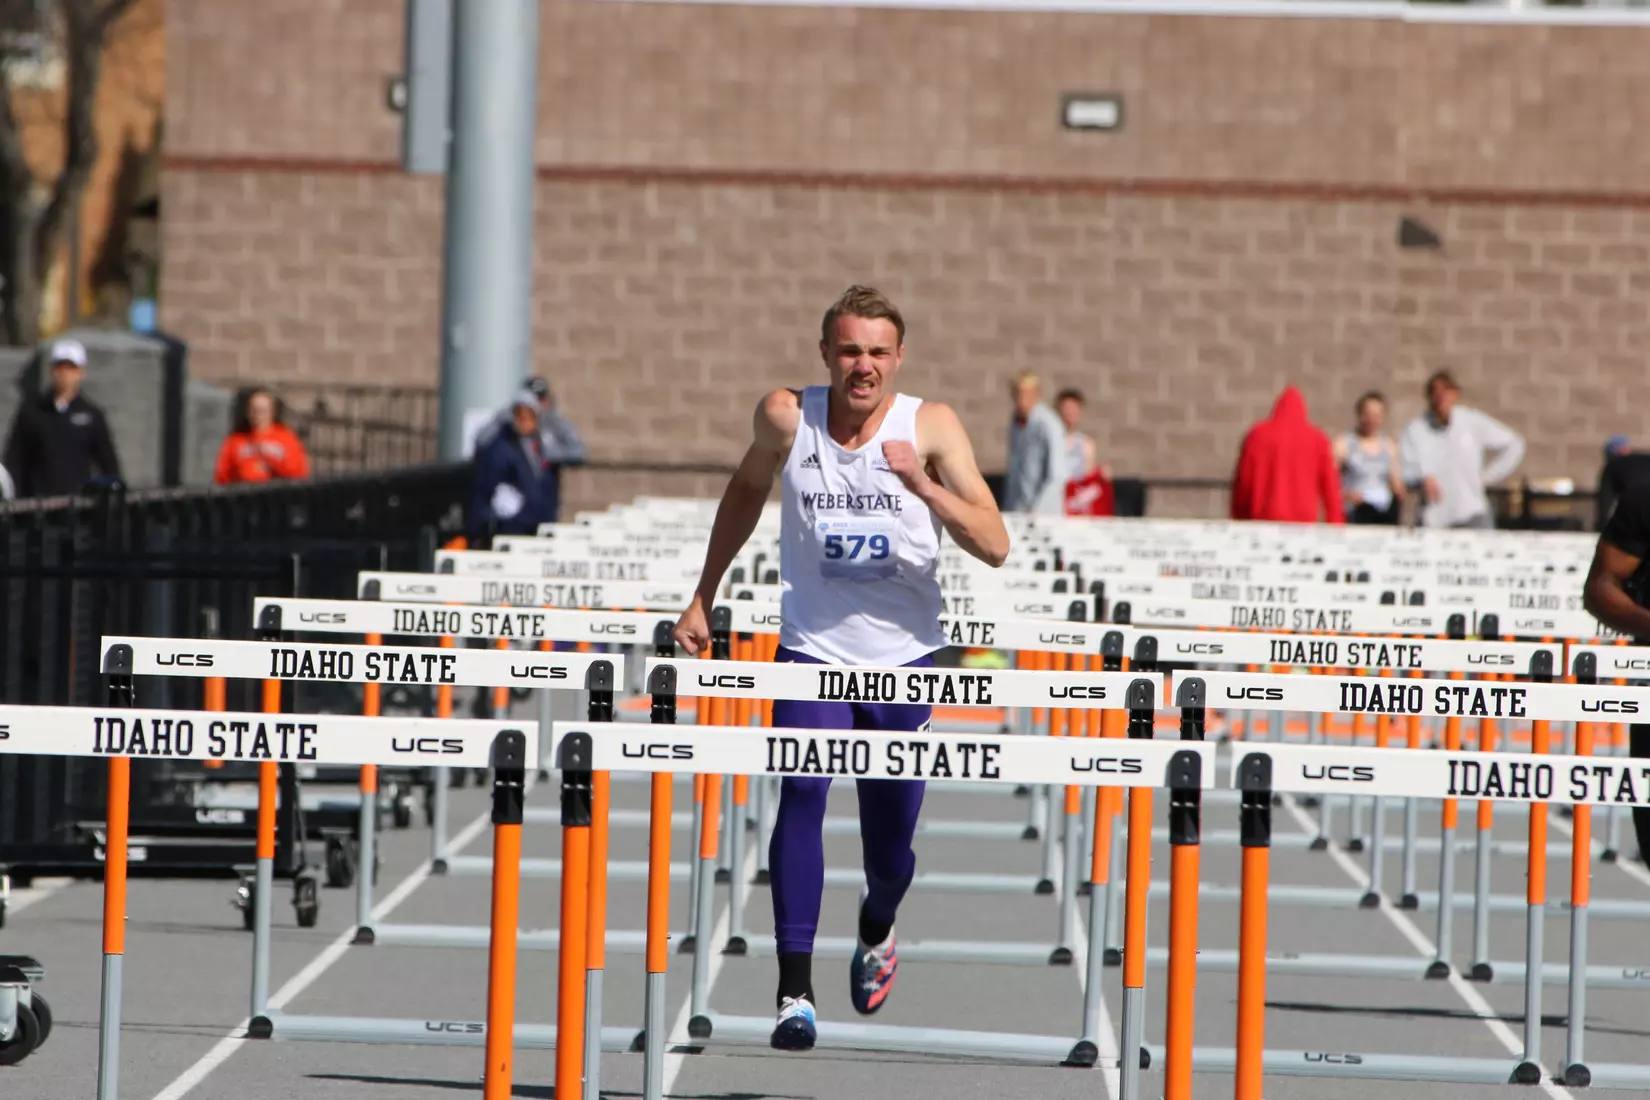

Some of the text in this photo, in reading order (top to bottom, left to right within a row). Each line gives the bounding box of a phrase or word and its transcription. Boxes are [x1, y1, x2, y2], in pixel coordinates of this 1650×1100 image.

[824, 534, 890, 560] 579
[481, 581, 604, 608] IDAHO STATE
[299, 612, 347, 624] UCS
[393, 609, 545, 637] IDAHO STATE
[751, 614, 781, 625] UC
[1230, 606, 1353, 631] IDAHO STATE
[590, 622, 637, 634] UCS
[1040, 633, 1086, 645] UCS
[1176, 642, 1223, 654] UCS
[1270, 640, 1423, 668] IDAHO STATE
[156, 653, 214, 667] UCS
[269, 648, 456, 683] IDAHO STATE
[1468, 653, 1515, 665] UCS
[1614, 659, 1650, 671] UC
[510, 665, 568, 680] UCS
[698, 674, 755, 688] UCS
[818, 670, 993, 705] IDAHO STATE
[1049, 685, 1107, 700] UCS
[1226, 686, 1284, 700] UCS
[1339, 682, 1527, 717] IDAHO STATE
[1581, 699, 1640, 713] UCS
[93, 717, 318, 760] IDAHO STATE
[392, 737, 464, 754] UCS
[622, 743, 694, 759] UCS
[766, 737, 1001, 779] IDAHO STATE
[1071, 757, 1142, 773] UCS
[1303, 764, 1375, 782] UCS
[1448, 760, 1554, 799] IDAHO
[425, 1021, 483, 1033] UCS
[1304, 1052, 1362, 1065] UCS
